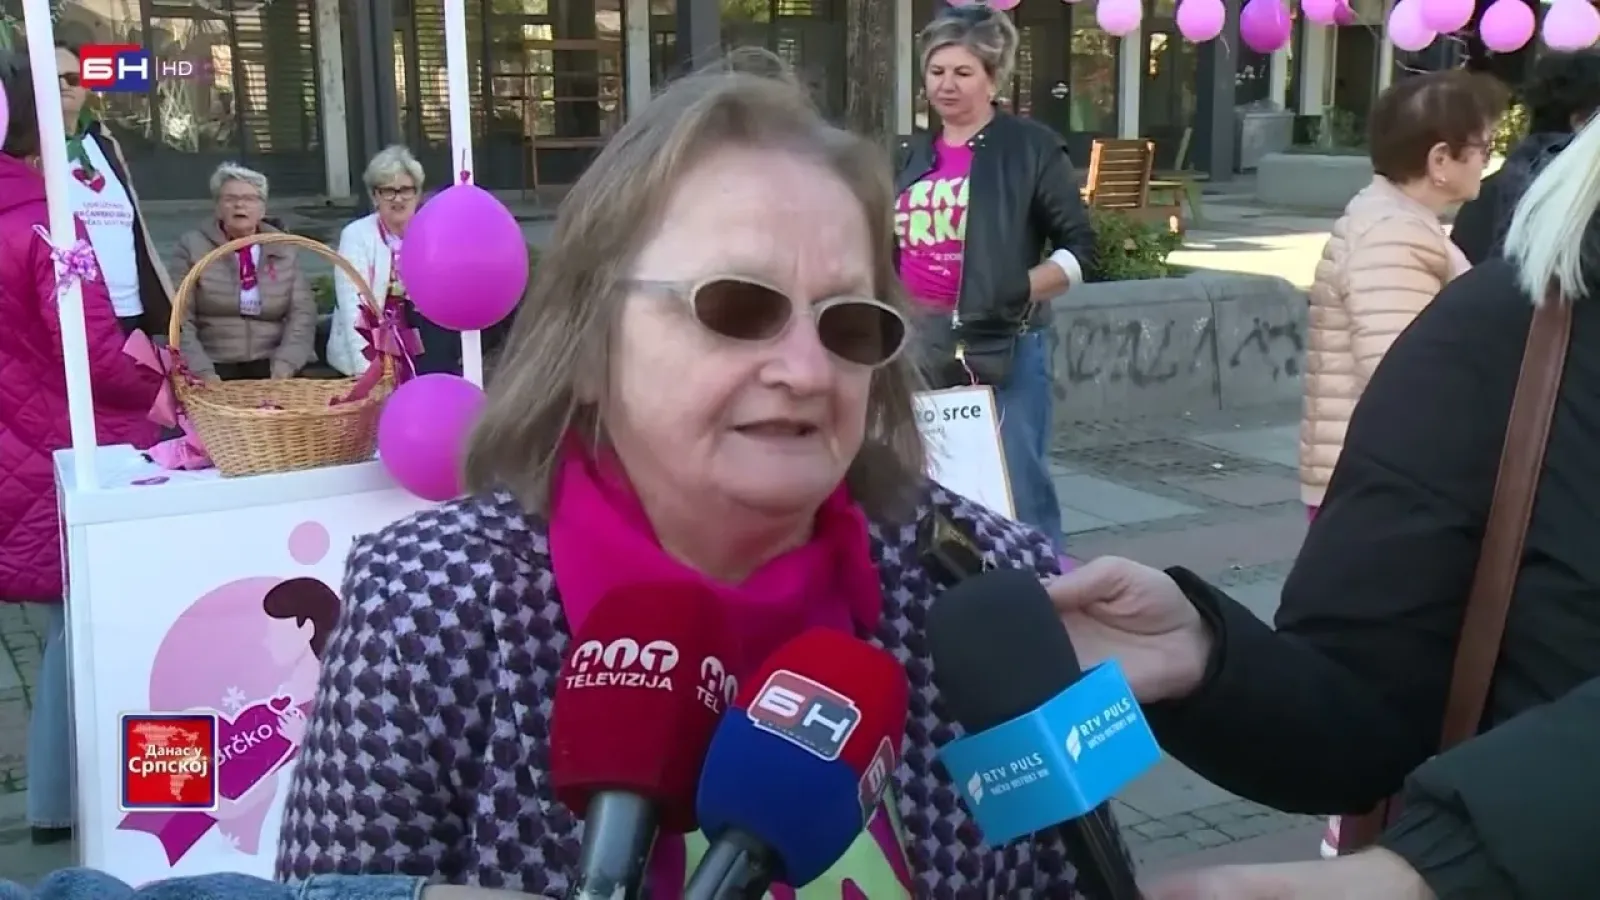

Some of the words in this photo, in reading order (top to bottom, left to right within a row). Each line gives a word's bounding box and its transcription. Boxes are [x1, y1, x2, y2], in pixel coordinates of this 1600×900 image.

[942, 404, 982, 421] srce
[571, 637, 680, 674] HIT
[565, 671, 673, 691] TELEVIZIJA
[1079, 720, 1101, 737] RTV
[1104, 697, 1131, 722] PULS
[983, 767, 1006, 784] RTV
[1010, 752, 1044, 773] PULS
